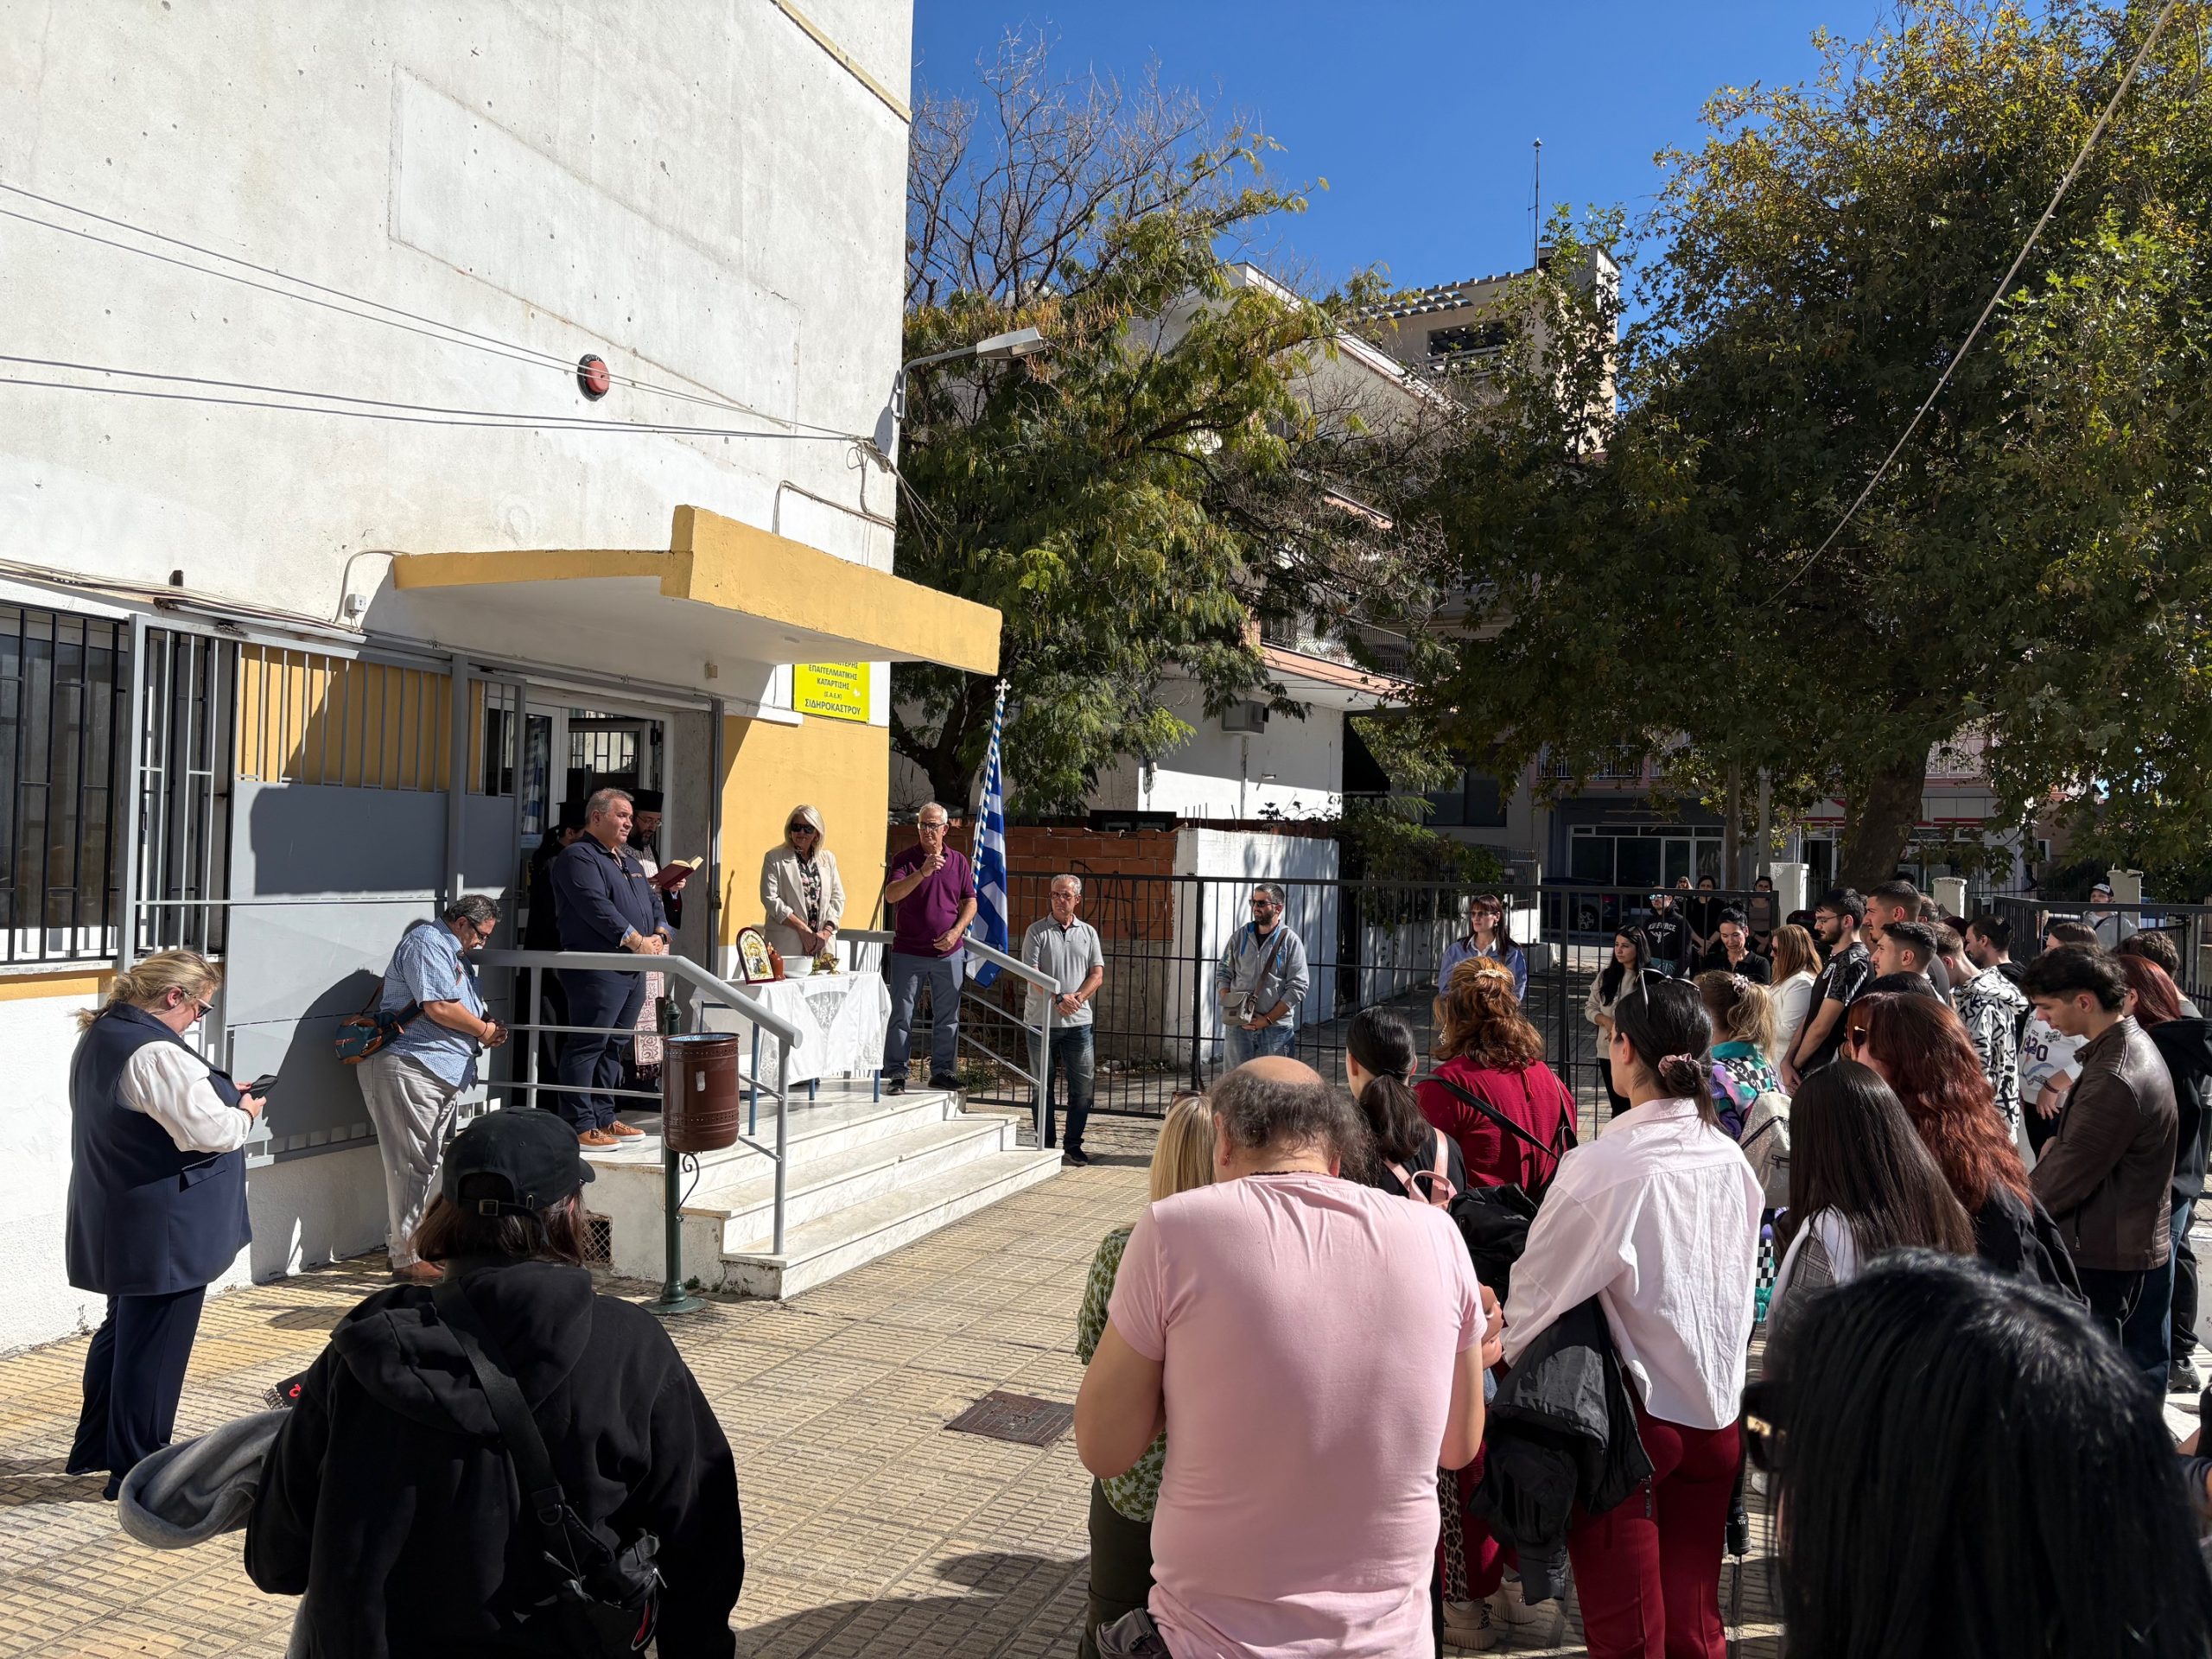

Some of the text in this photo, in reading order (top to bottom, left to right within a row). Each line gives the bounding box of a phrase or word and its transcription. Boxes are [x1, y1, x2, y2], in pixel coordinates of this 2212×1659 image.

[809, 664, 857, 680] ΕΠΑΓΓΕΛΜΑΤΙΚΗΣ
[817, 677, 849, 690] ΚΑΤΑΡΤΙΣΗΣ
[804, 698, 861, 715] ΣΙΔΗΡΟΚΑΣΤΡΟΥ
